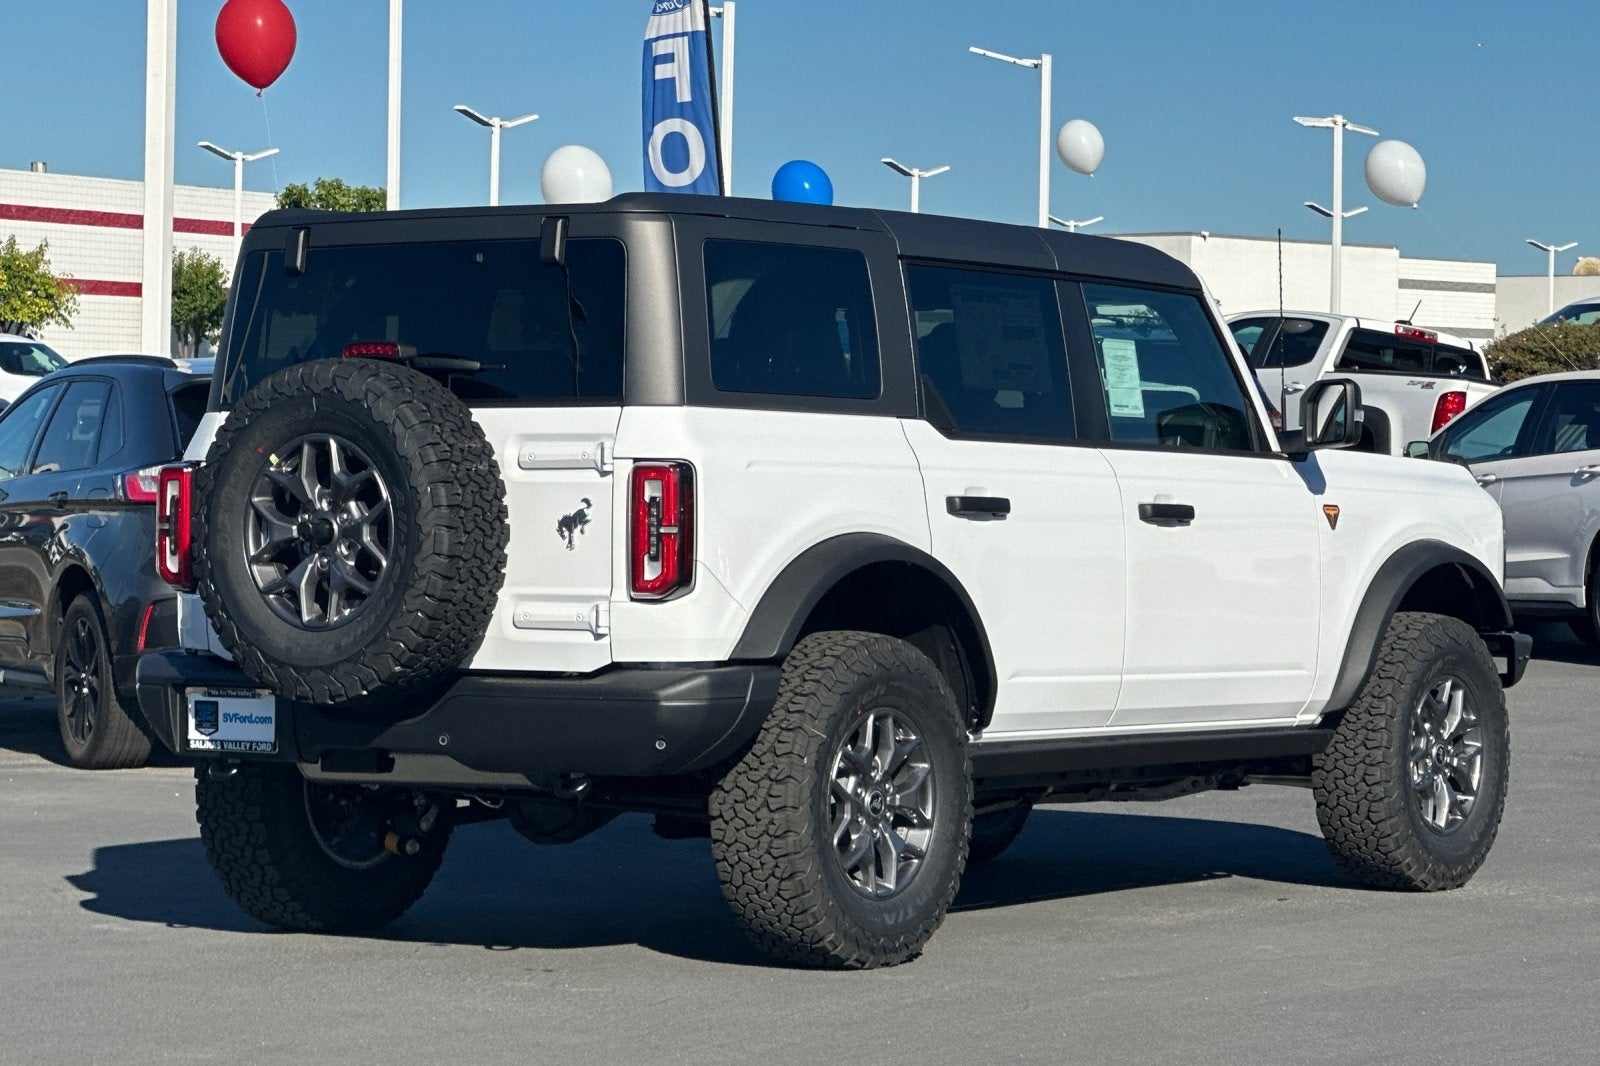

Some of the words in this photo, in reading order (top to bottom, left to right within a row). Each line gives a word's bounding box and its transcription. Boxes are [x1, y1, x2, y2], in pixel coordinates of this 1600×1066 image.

[222, 713, 272, 724] SVFord.com
[190, 740, 221, 749] SALINAS
[223, 741, 252, 751] VALLEY
[252, 742, 273, 752] FORD
